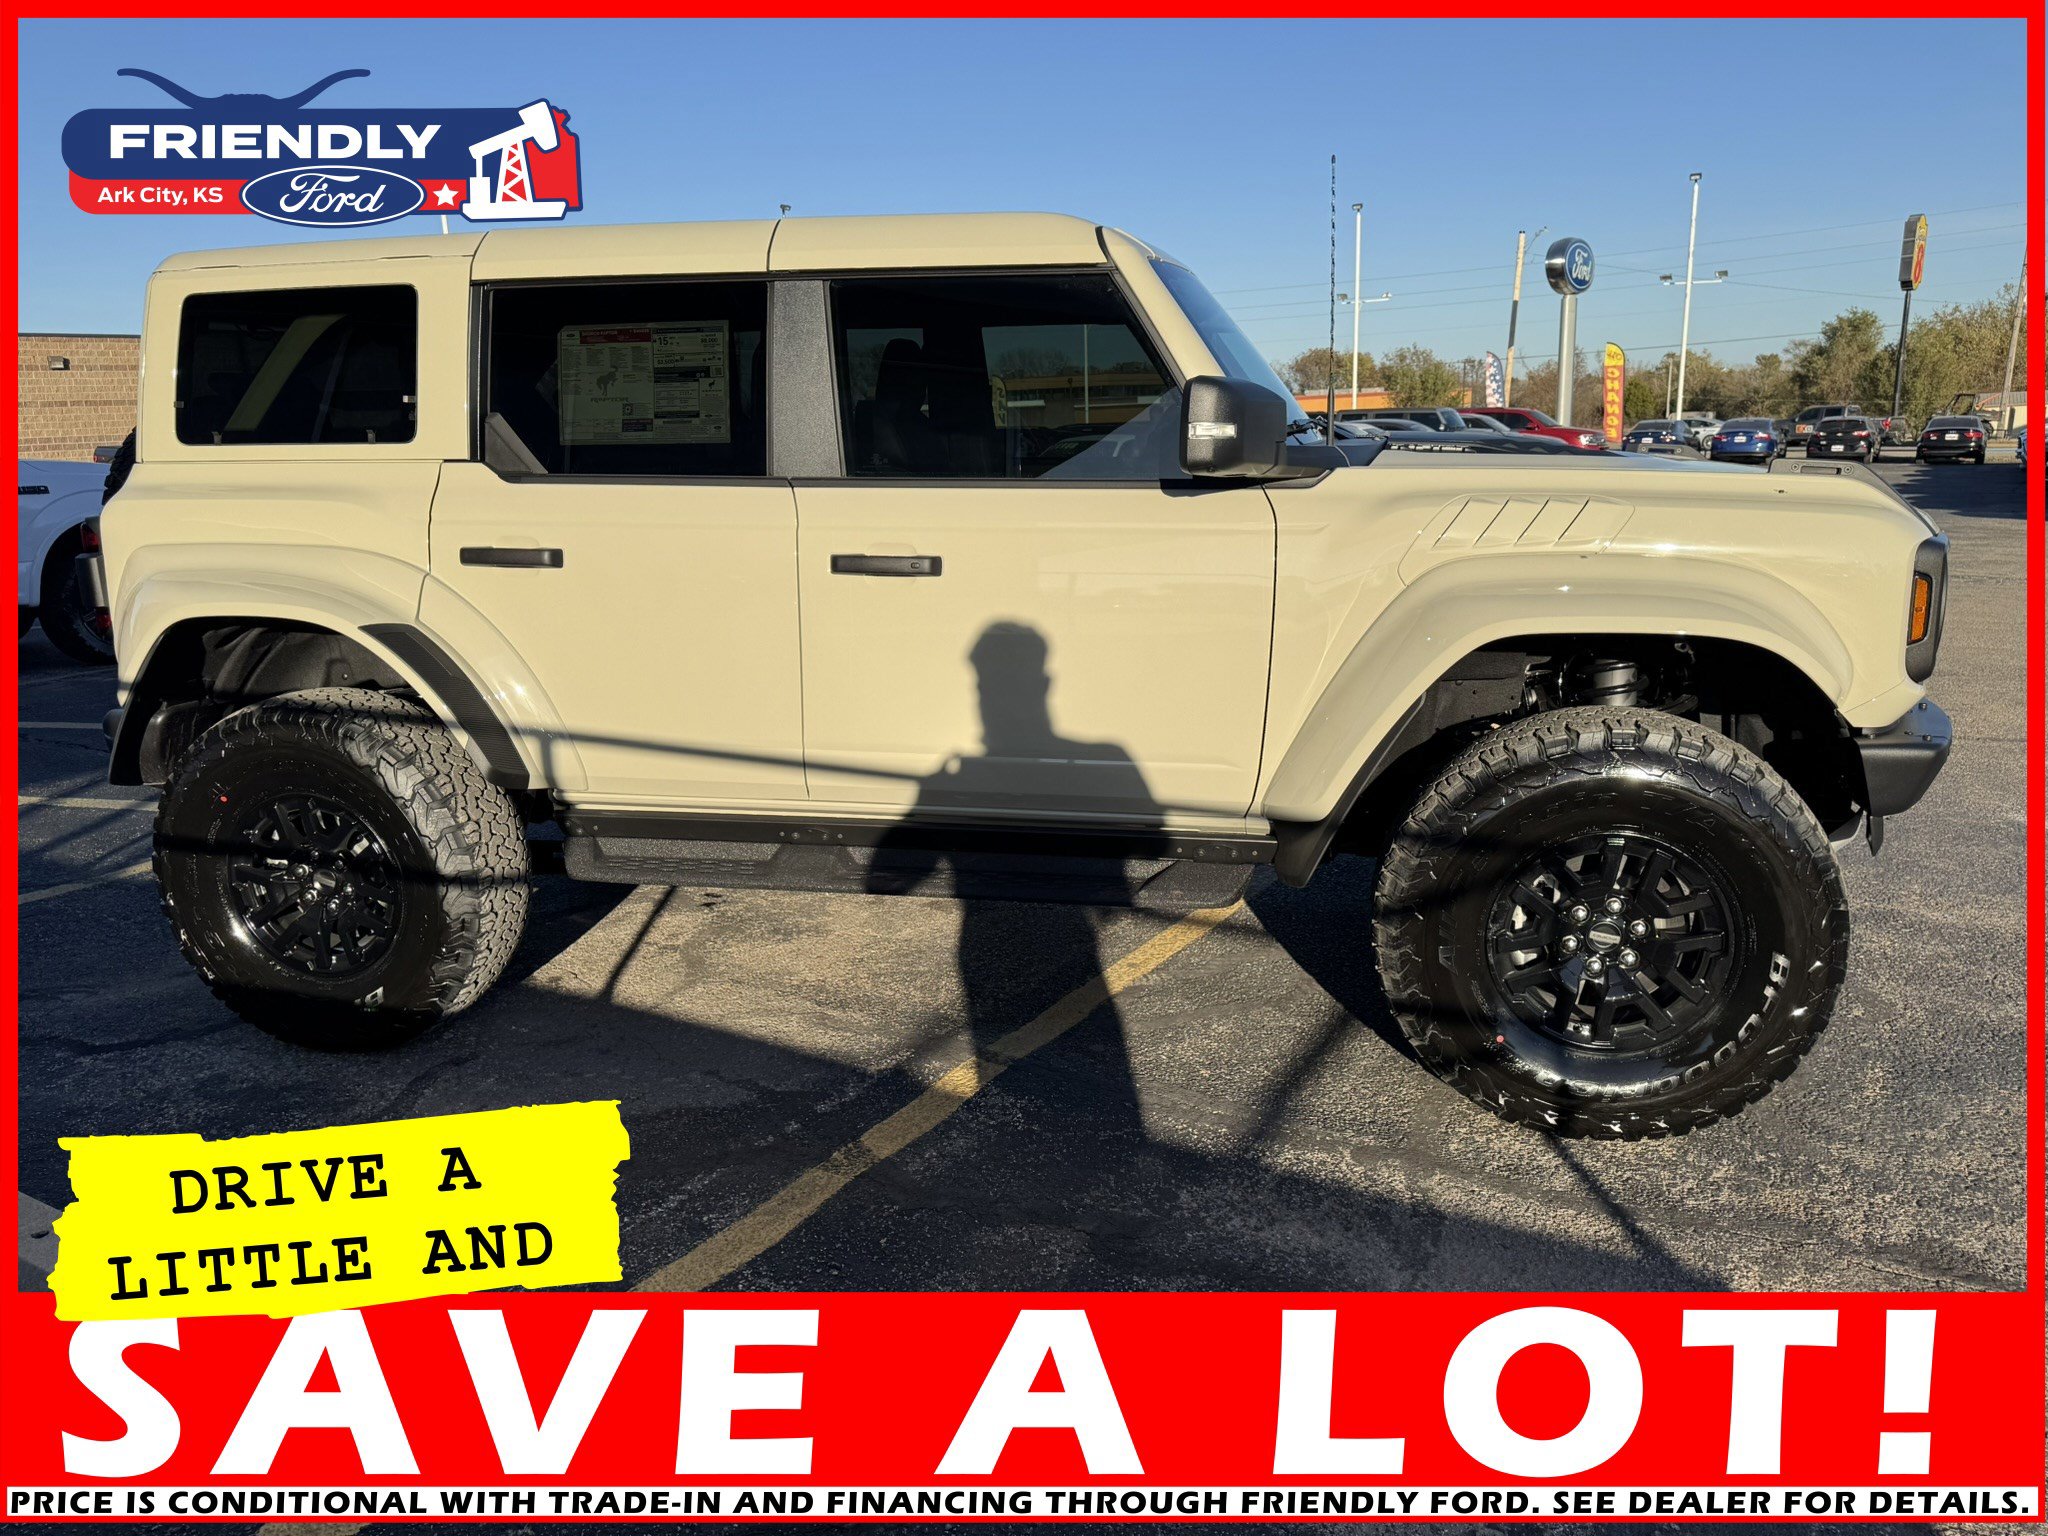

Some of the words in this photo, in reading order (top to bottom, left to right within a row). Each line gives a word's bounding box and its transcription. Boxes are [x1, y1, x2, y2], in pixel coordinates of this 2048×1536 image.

[1572, 248, 1591, 281] Ford
[657, 336, 669, 346] 15
[1535, 951, 1791, 1101] BFGoodrich
